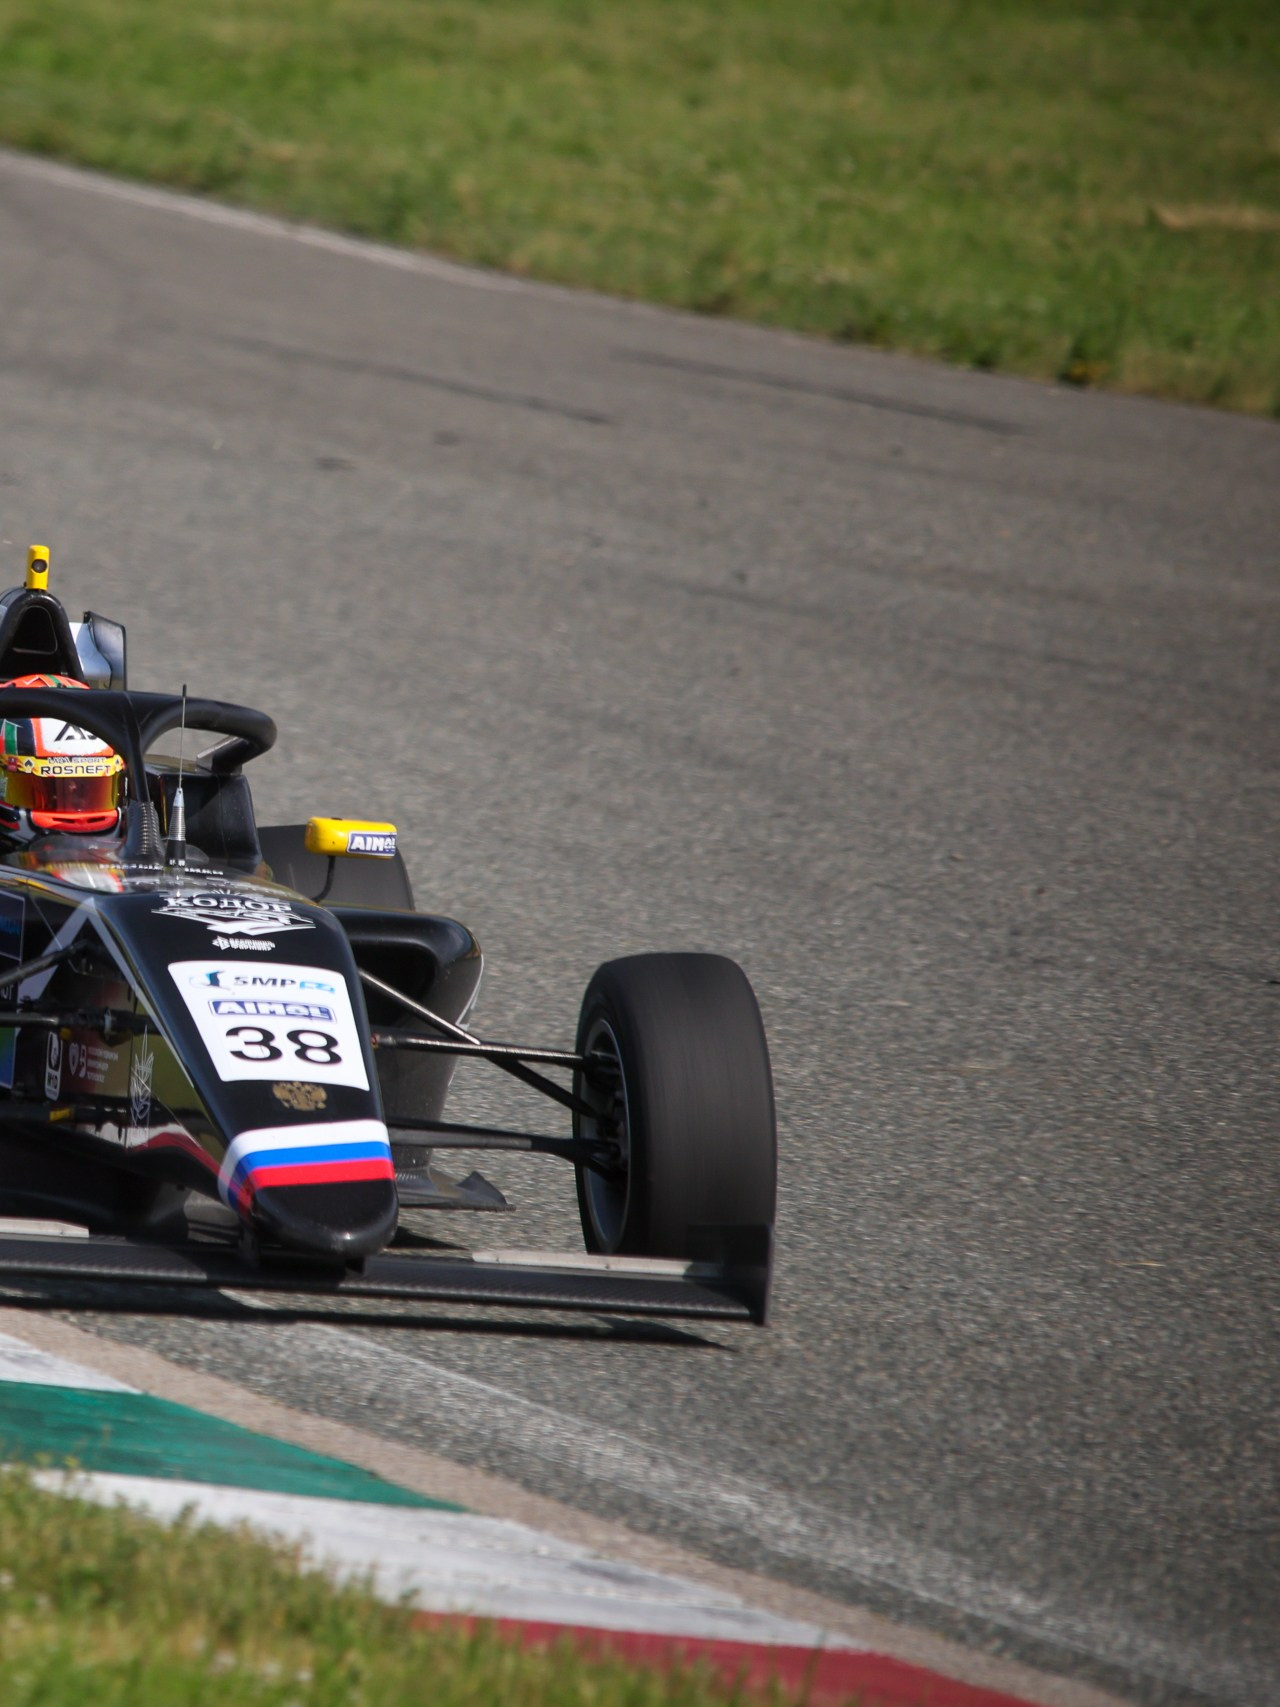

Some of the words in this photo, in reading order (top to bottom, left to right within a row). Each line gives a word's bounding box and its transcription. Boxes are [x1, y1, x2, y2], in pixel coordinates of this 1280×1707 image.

[40, 765, 111, 775] ROSNEFT
[217, 1001, 331, 1019] AIMOL
[225, 1026, 343, 1065] 38
